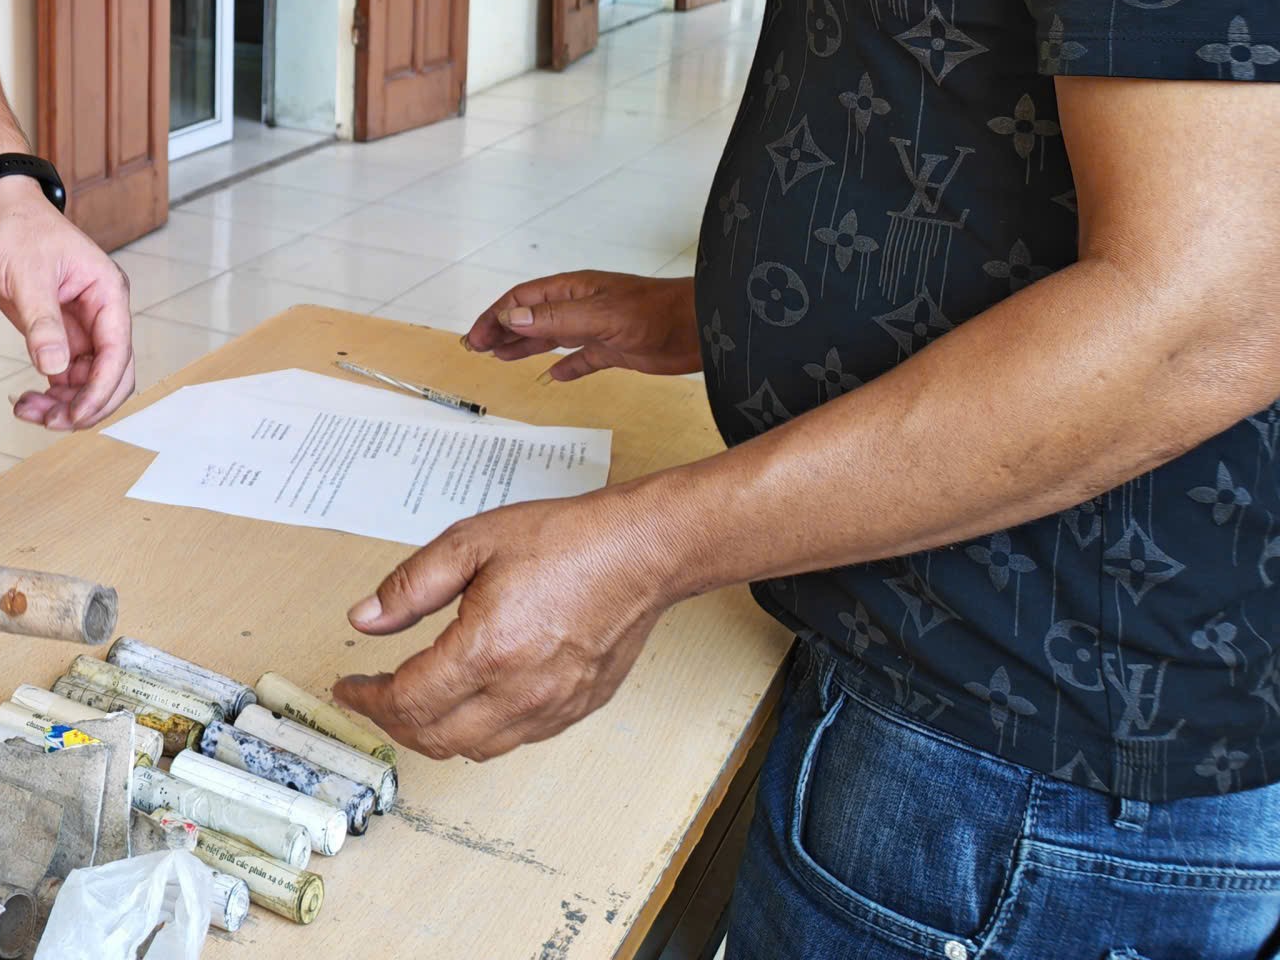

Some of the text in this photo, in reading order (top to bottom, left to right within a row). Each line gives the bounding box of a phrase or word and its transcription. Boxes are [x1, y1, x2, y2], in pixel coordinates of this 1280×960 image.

[205, 842, 219, 857] biệt
[219, 850, 236, 865] giữa
[235, 859, 249, 870] các
[248, 865, 267, 879] phản
[267, 874, 277, 885] xạ
[284, 880, 299, 895] độn
